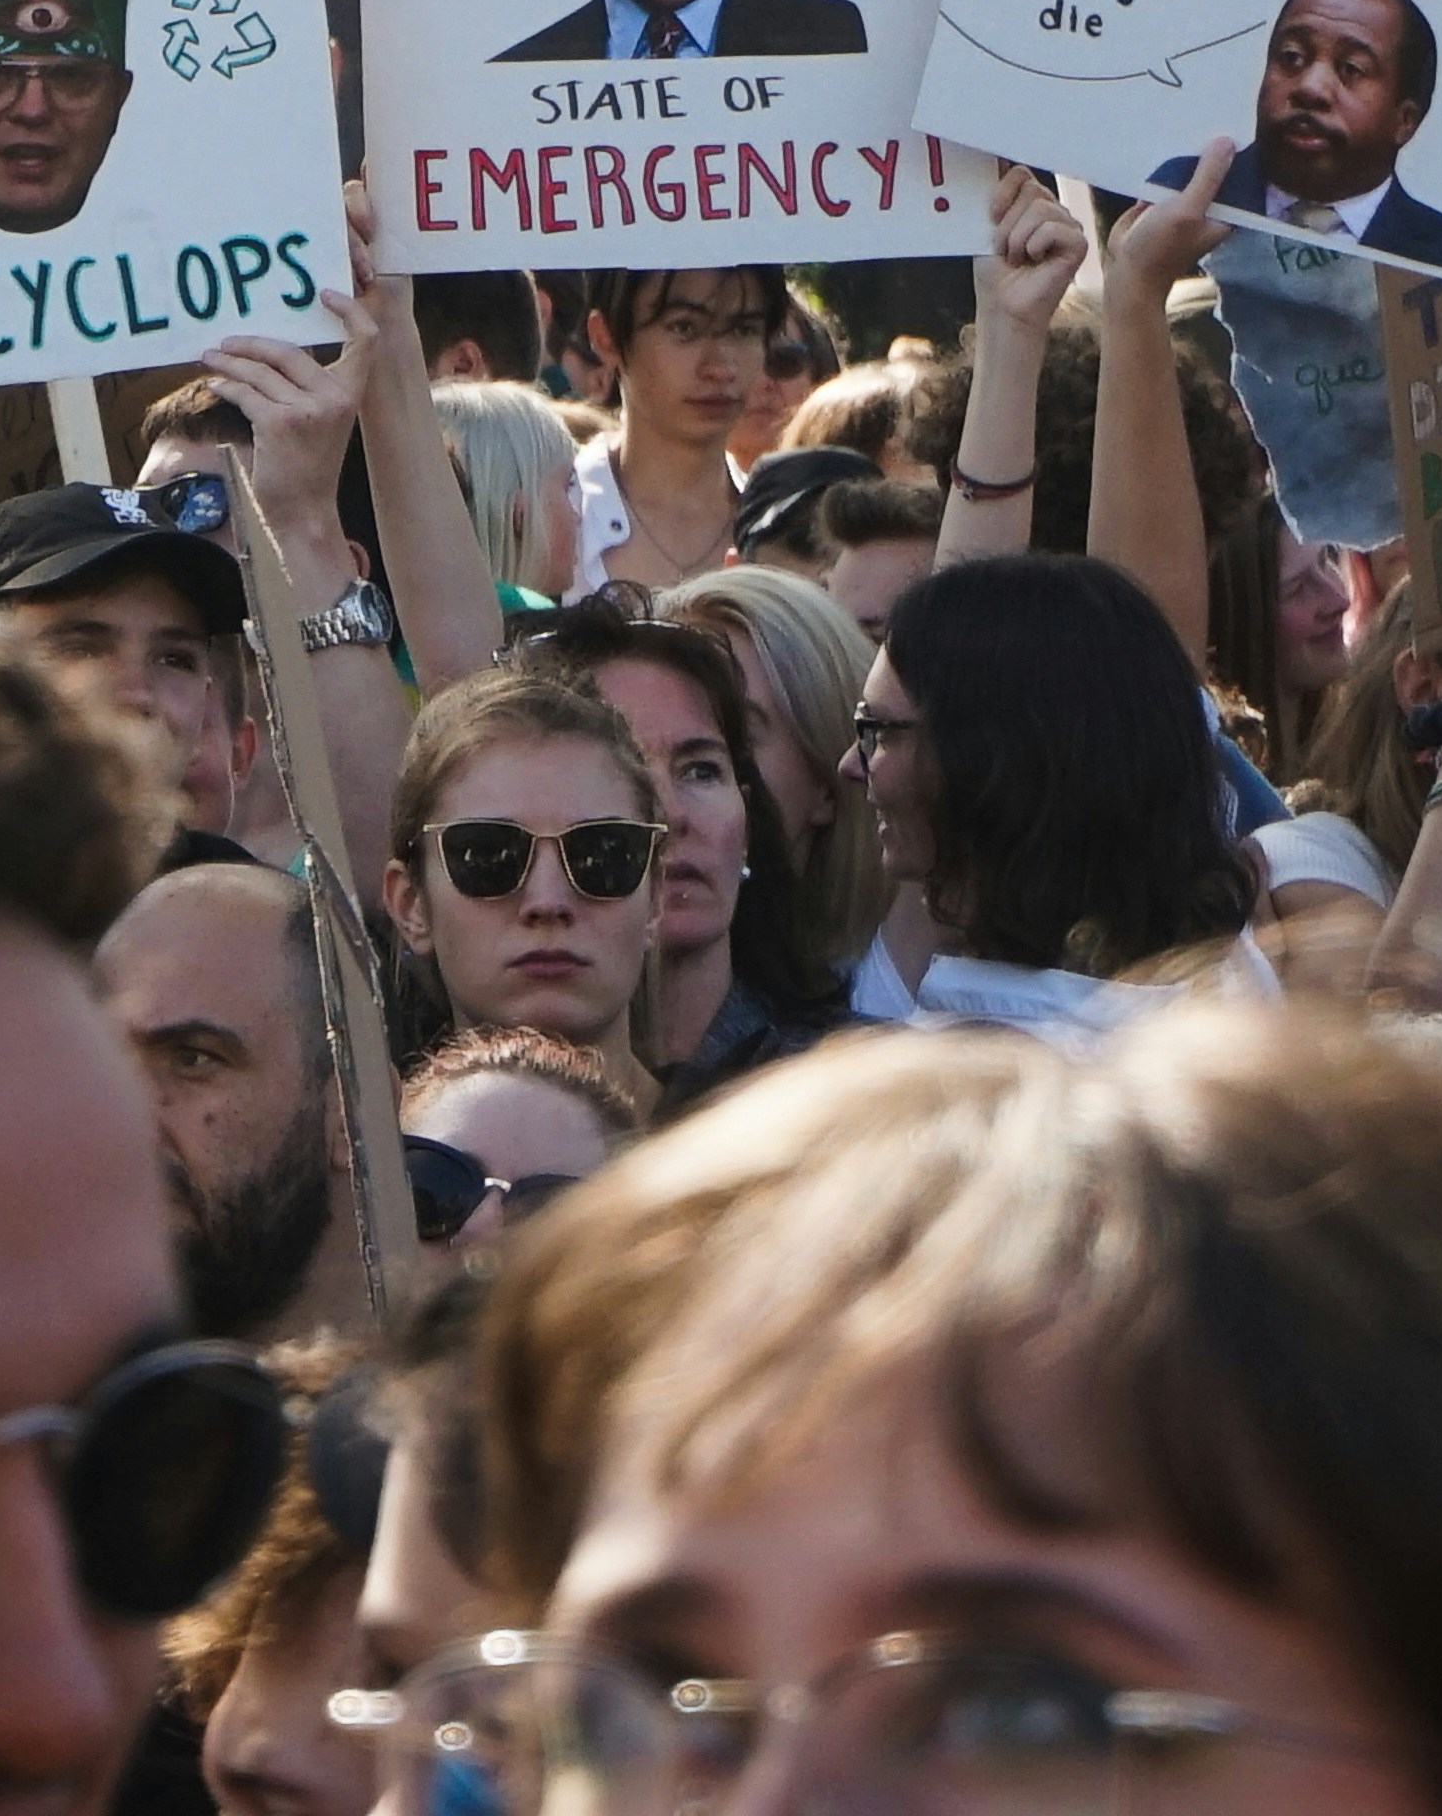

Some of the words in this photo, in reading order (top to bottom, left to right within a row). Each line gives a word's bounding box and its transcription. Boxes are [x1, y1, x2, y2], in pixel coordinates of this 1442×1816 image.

[531, 75, 688, 125] STATE
[723, 75, 785, 112] OF
[414, 133, 950, 235] EMERGENCY!
